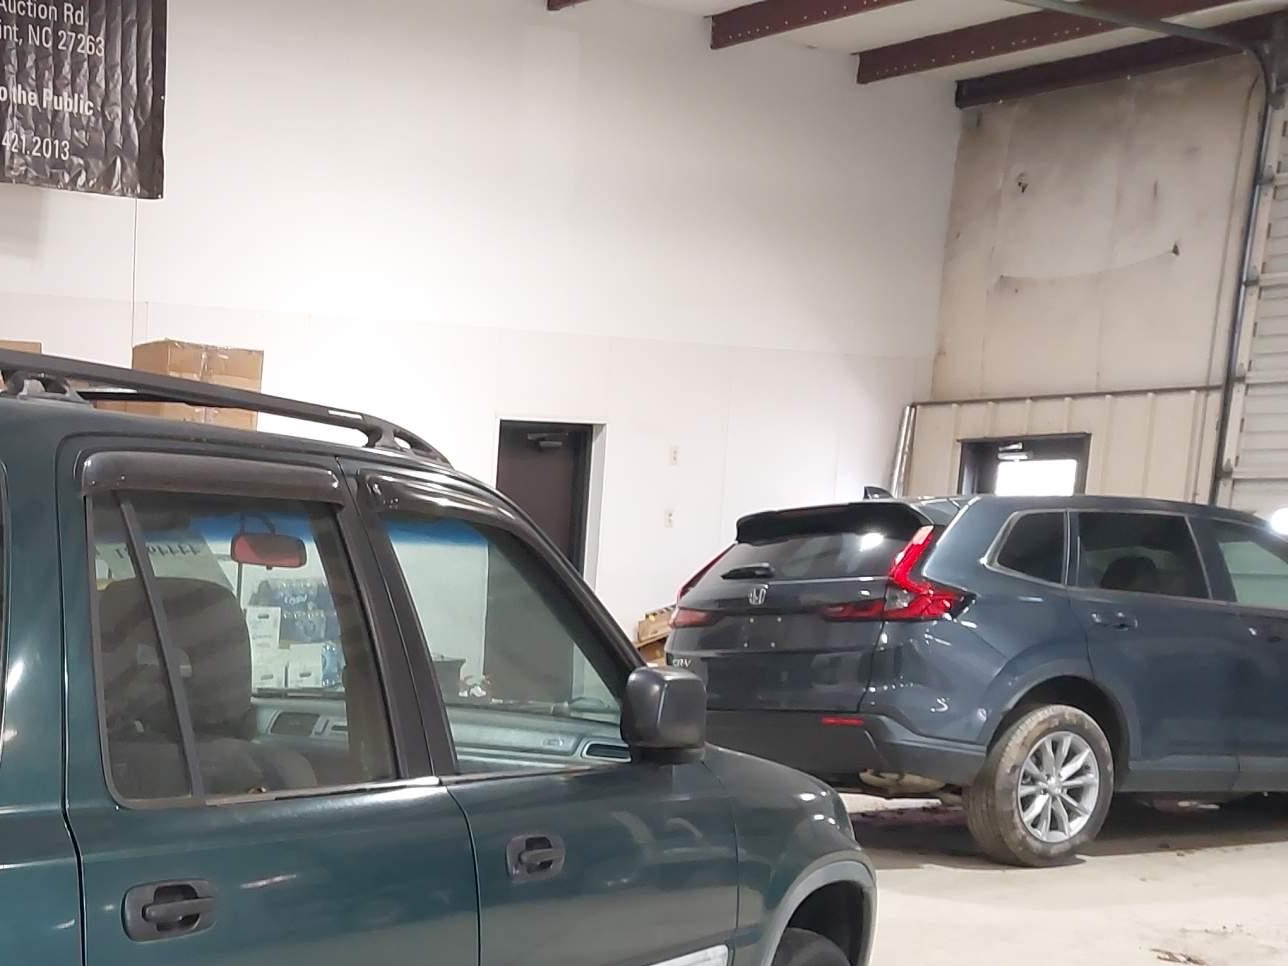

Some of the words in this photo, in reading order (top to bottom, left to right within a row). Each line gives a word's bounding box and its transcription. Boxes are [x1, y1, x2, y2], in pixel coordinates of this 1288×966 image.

[28, 24, 52, 48] NC
[57, 31, 105, 57] 27263
[12, 83, 37, 106] the
[42, 87, 94, 116] Public
